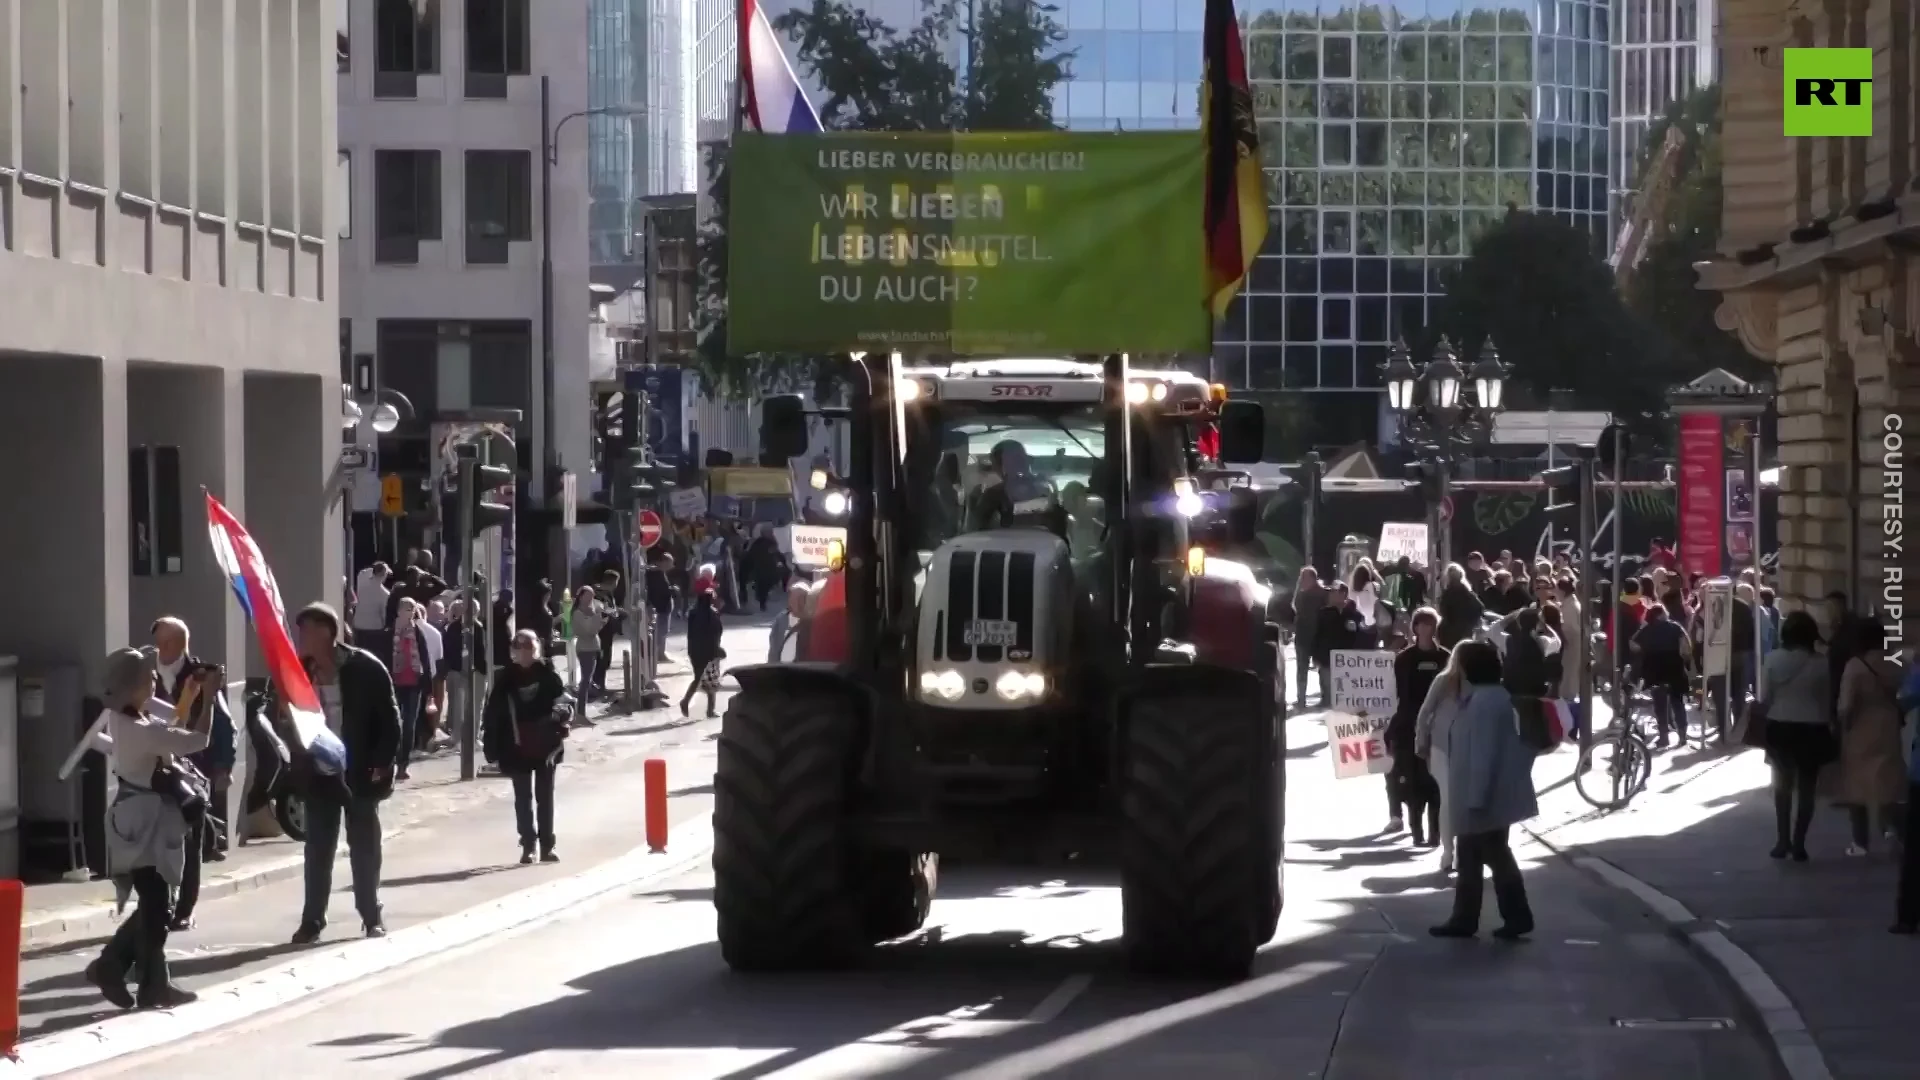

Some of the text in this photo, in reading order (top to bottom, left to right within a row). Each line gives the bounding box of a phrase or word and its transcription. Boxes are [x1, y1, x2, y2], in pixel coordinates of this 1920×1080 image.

[818, 150, 1085, 172] LIEBER VERBRAUCHER!
[819, 192, 1003, 220] WIR LIEBEN
[820, 233, 1053, 262] LEBENSMITTEL.
[819, 275, 979, 302] DU AUCH?
[991, 384, 1053, 397] STEYR
[1334, 653, 1394, 668] Bohren
[1334, 720, 1369, 740] WANN
